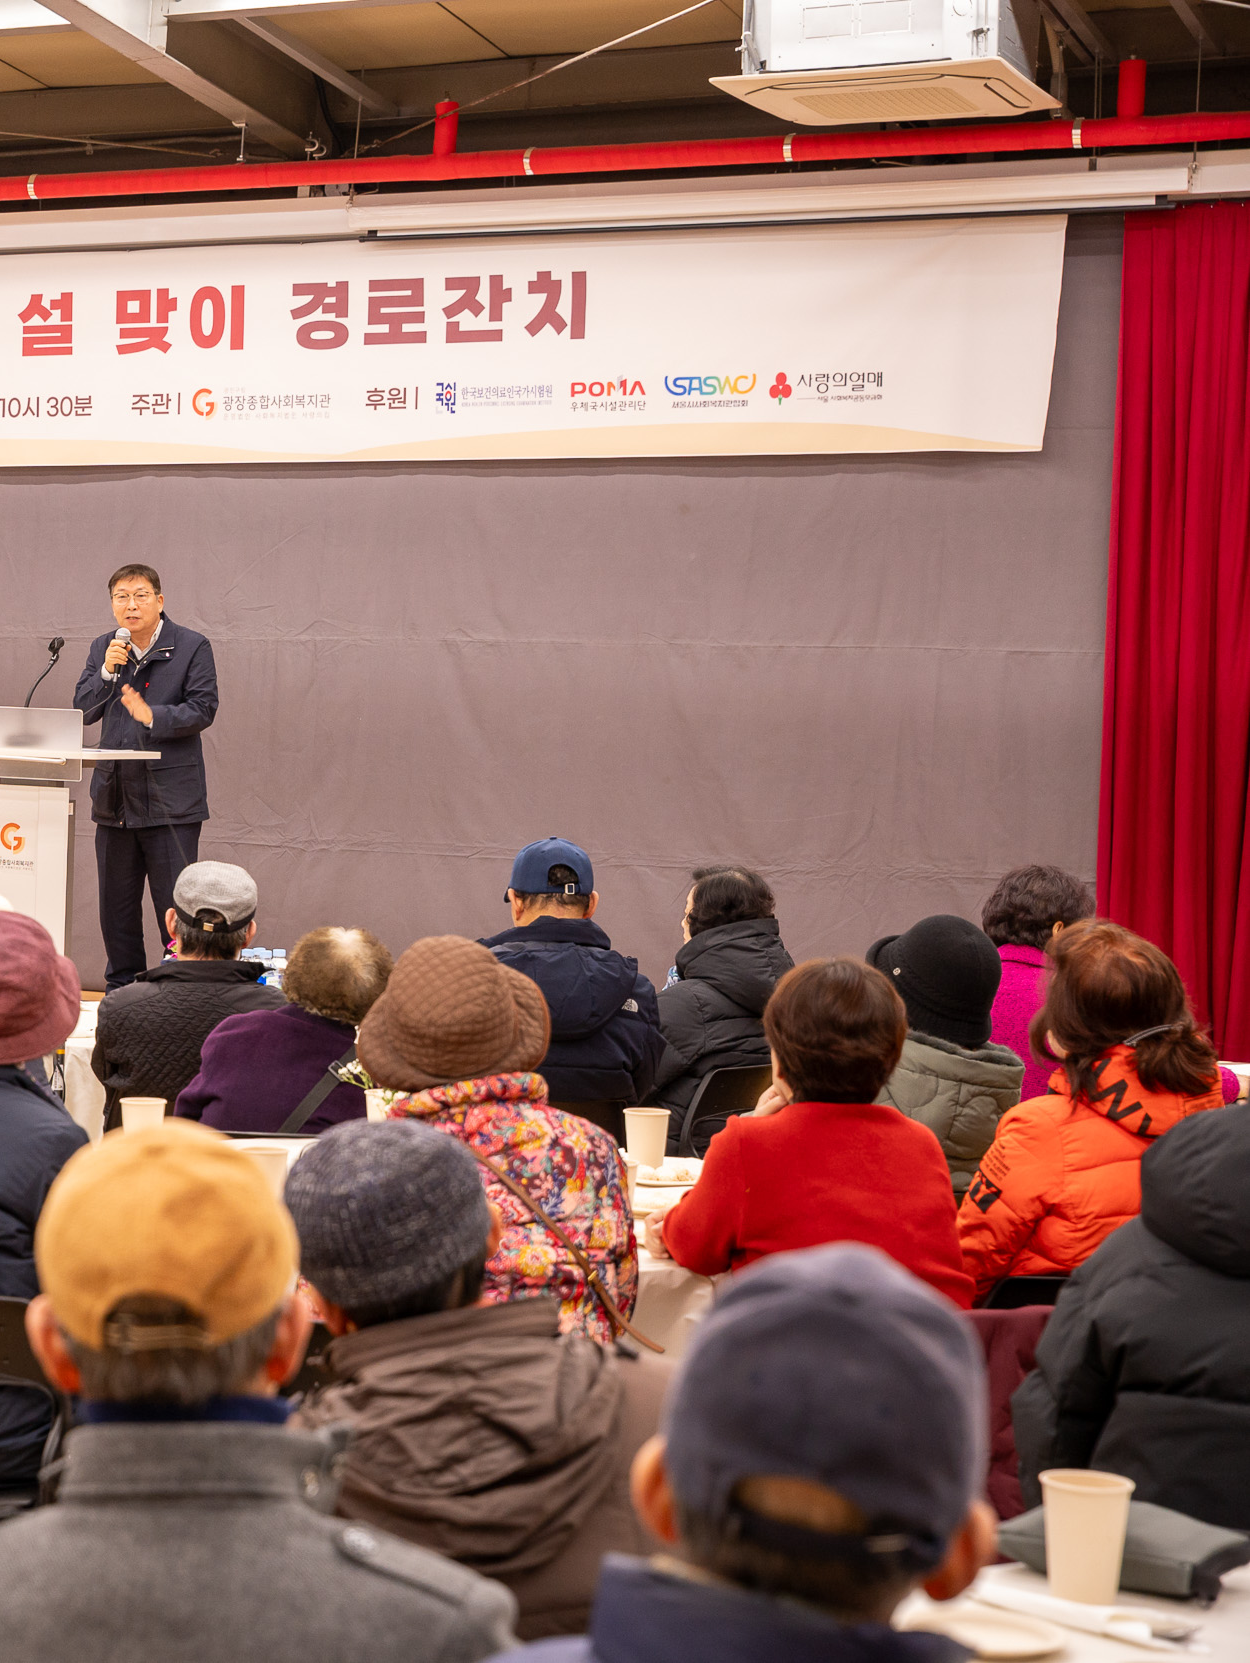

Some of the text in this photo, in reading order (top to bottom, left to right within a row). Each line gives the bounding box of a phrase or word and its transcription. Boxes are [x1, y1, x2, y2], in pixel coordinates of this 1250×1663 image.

[17, 270, 587, 357] 설 맞이 경로잔치
[461, 385, 553, 400] 한국보건의료인국가시험원
[570, 377, 646, 397] POMA
[796, 371, 883, 394] 사랑의열매
[46, 395, 93, 418] 30분
[131, 392, 172, 416] 주관
[222, 393, 332, 412] 광장종합사회복지관
[365, 387, 408, 411] 후원
[570, 400, 646, 412] 우체국시설관리단
